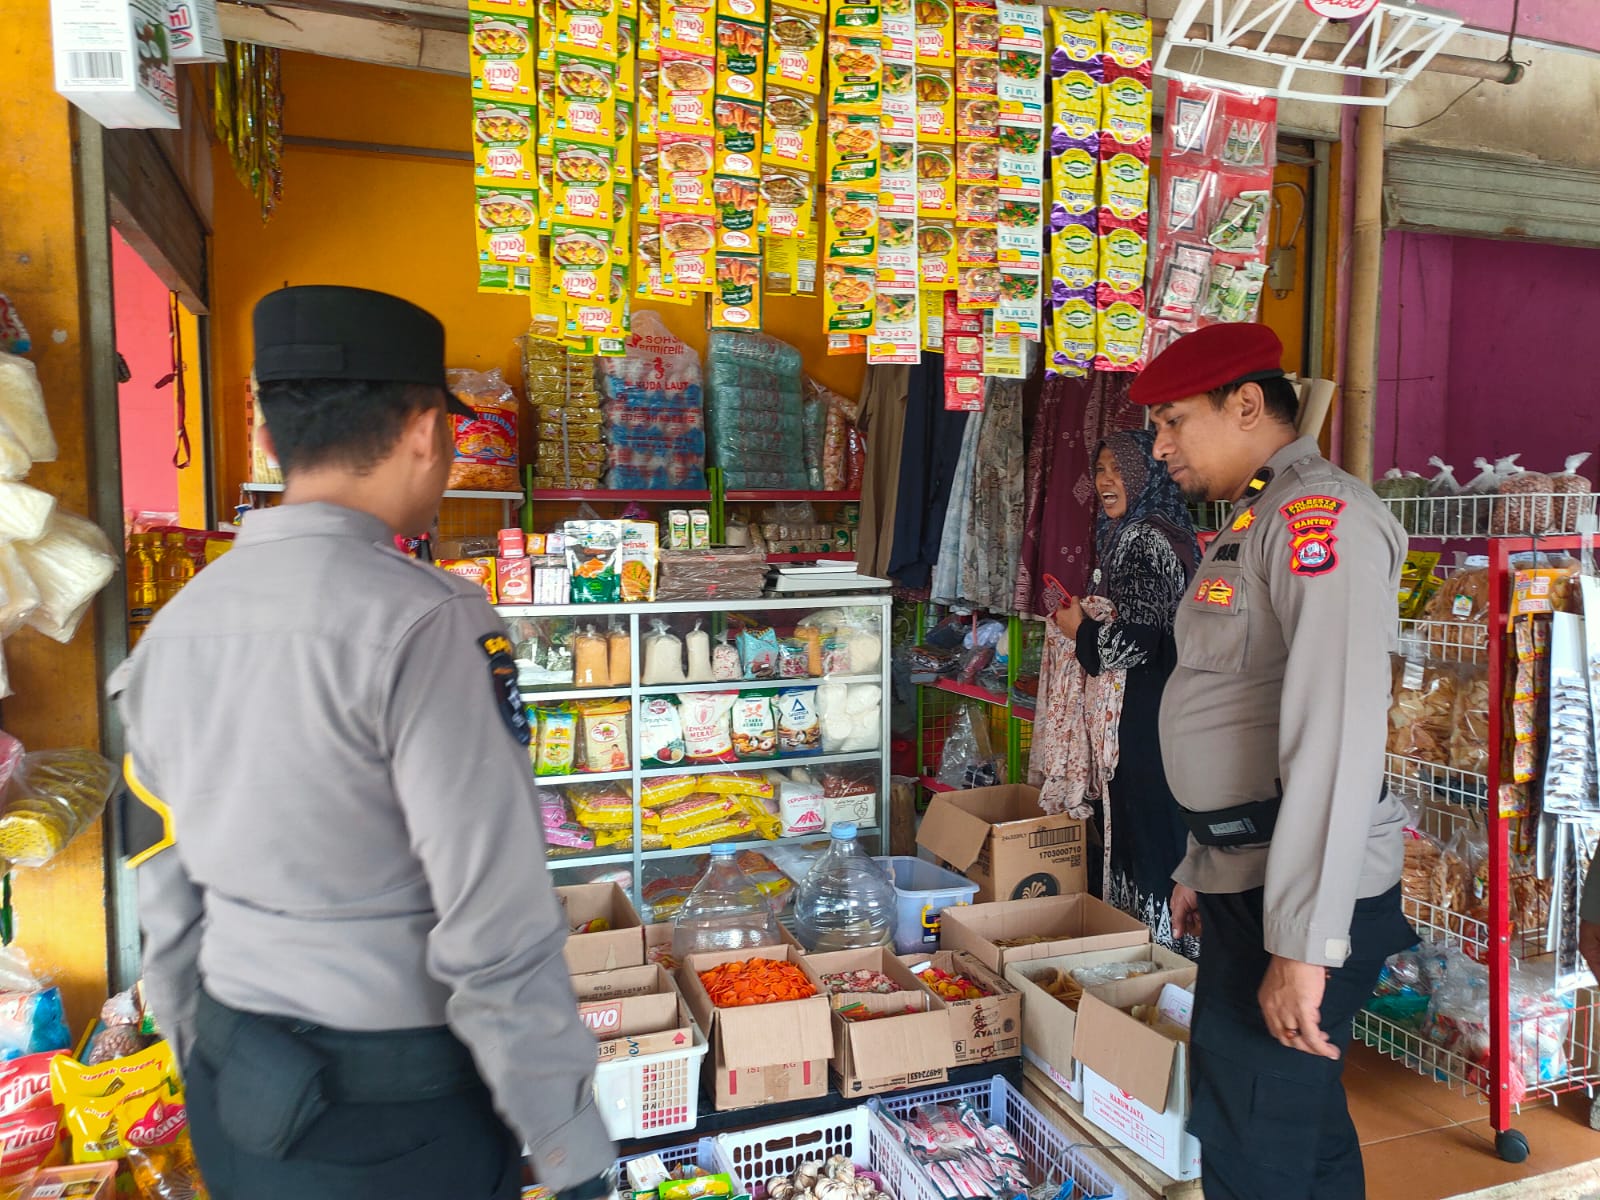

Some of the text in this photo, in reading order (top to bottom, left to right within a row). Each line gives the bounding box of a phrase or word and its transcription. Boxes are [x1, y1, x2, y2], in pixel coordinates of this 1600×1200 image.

[1003, 11, 1038, 22] TUMIS
[569, 22, 604, 39] Racik
[672, 18, 705, 35] Racik
[778, 56, 810, 72] Racik
[483, 66, 520, 81] Racik
[1003, 86, 1037, 97] TUMIS
[567, 108, 602, 124] Racik
[670, 102, 704, 116] Racik
[774, 135, 804, 151] Racik
[486, 154, 522, 167] Racik
[1002, 161, 1037, 171] TUMIS
[672, 182, 704, 197] Racik
[565, 193, 600, 208] Racik
[767, 213, 799, 228] Racik
[489, 239, 526, 254] Racik
[1001, 236, 1036, 245] TUMIS
[878, 255, 911, 264] CAPCA
[673, 262, 706, 276] Racik
[562, 277, 597, 291] Racik
[577, 311, 612, 324] Racik
[664, 381, 689, 391] LAUT
[1294, 518, 1332, 529] BANTEN
[448, 567, 484, 576] PALMIA
[955, 1042, 962, 1052] 6
[1130, 1106, 1145, 1122] JAYA
